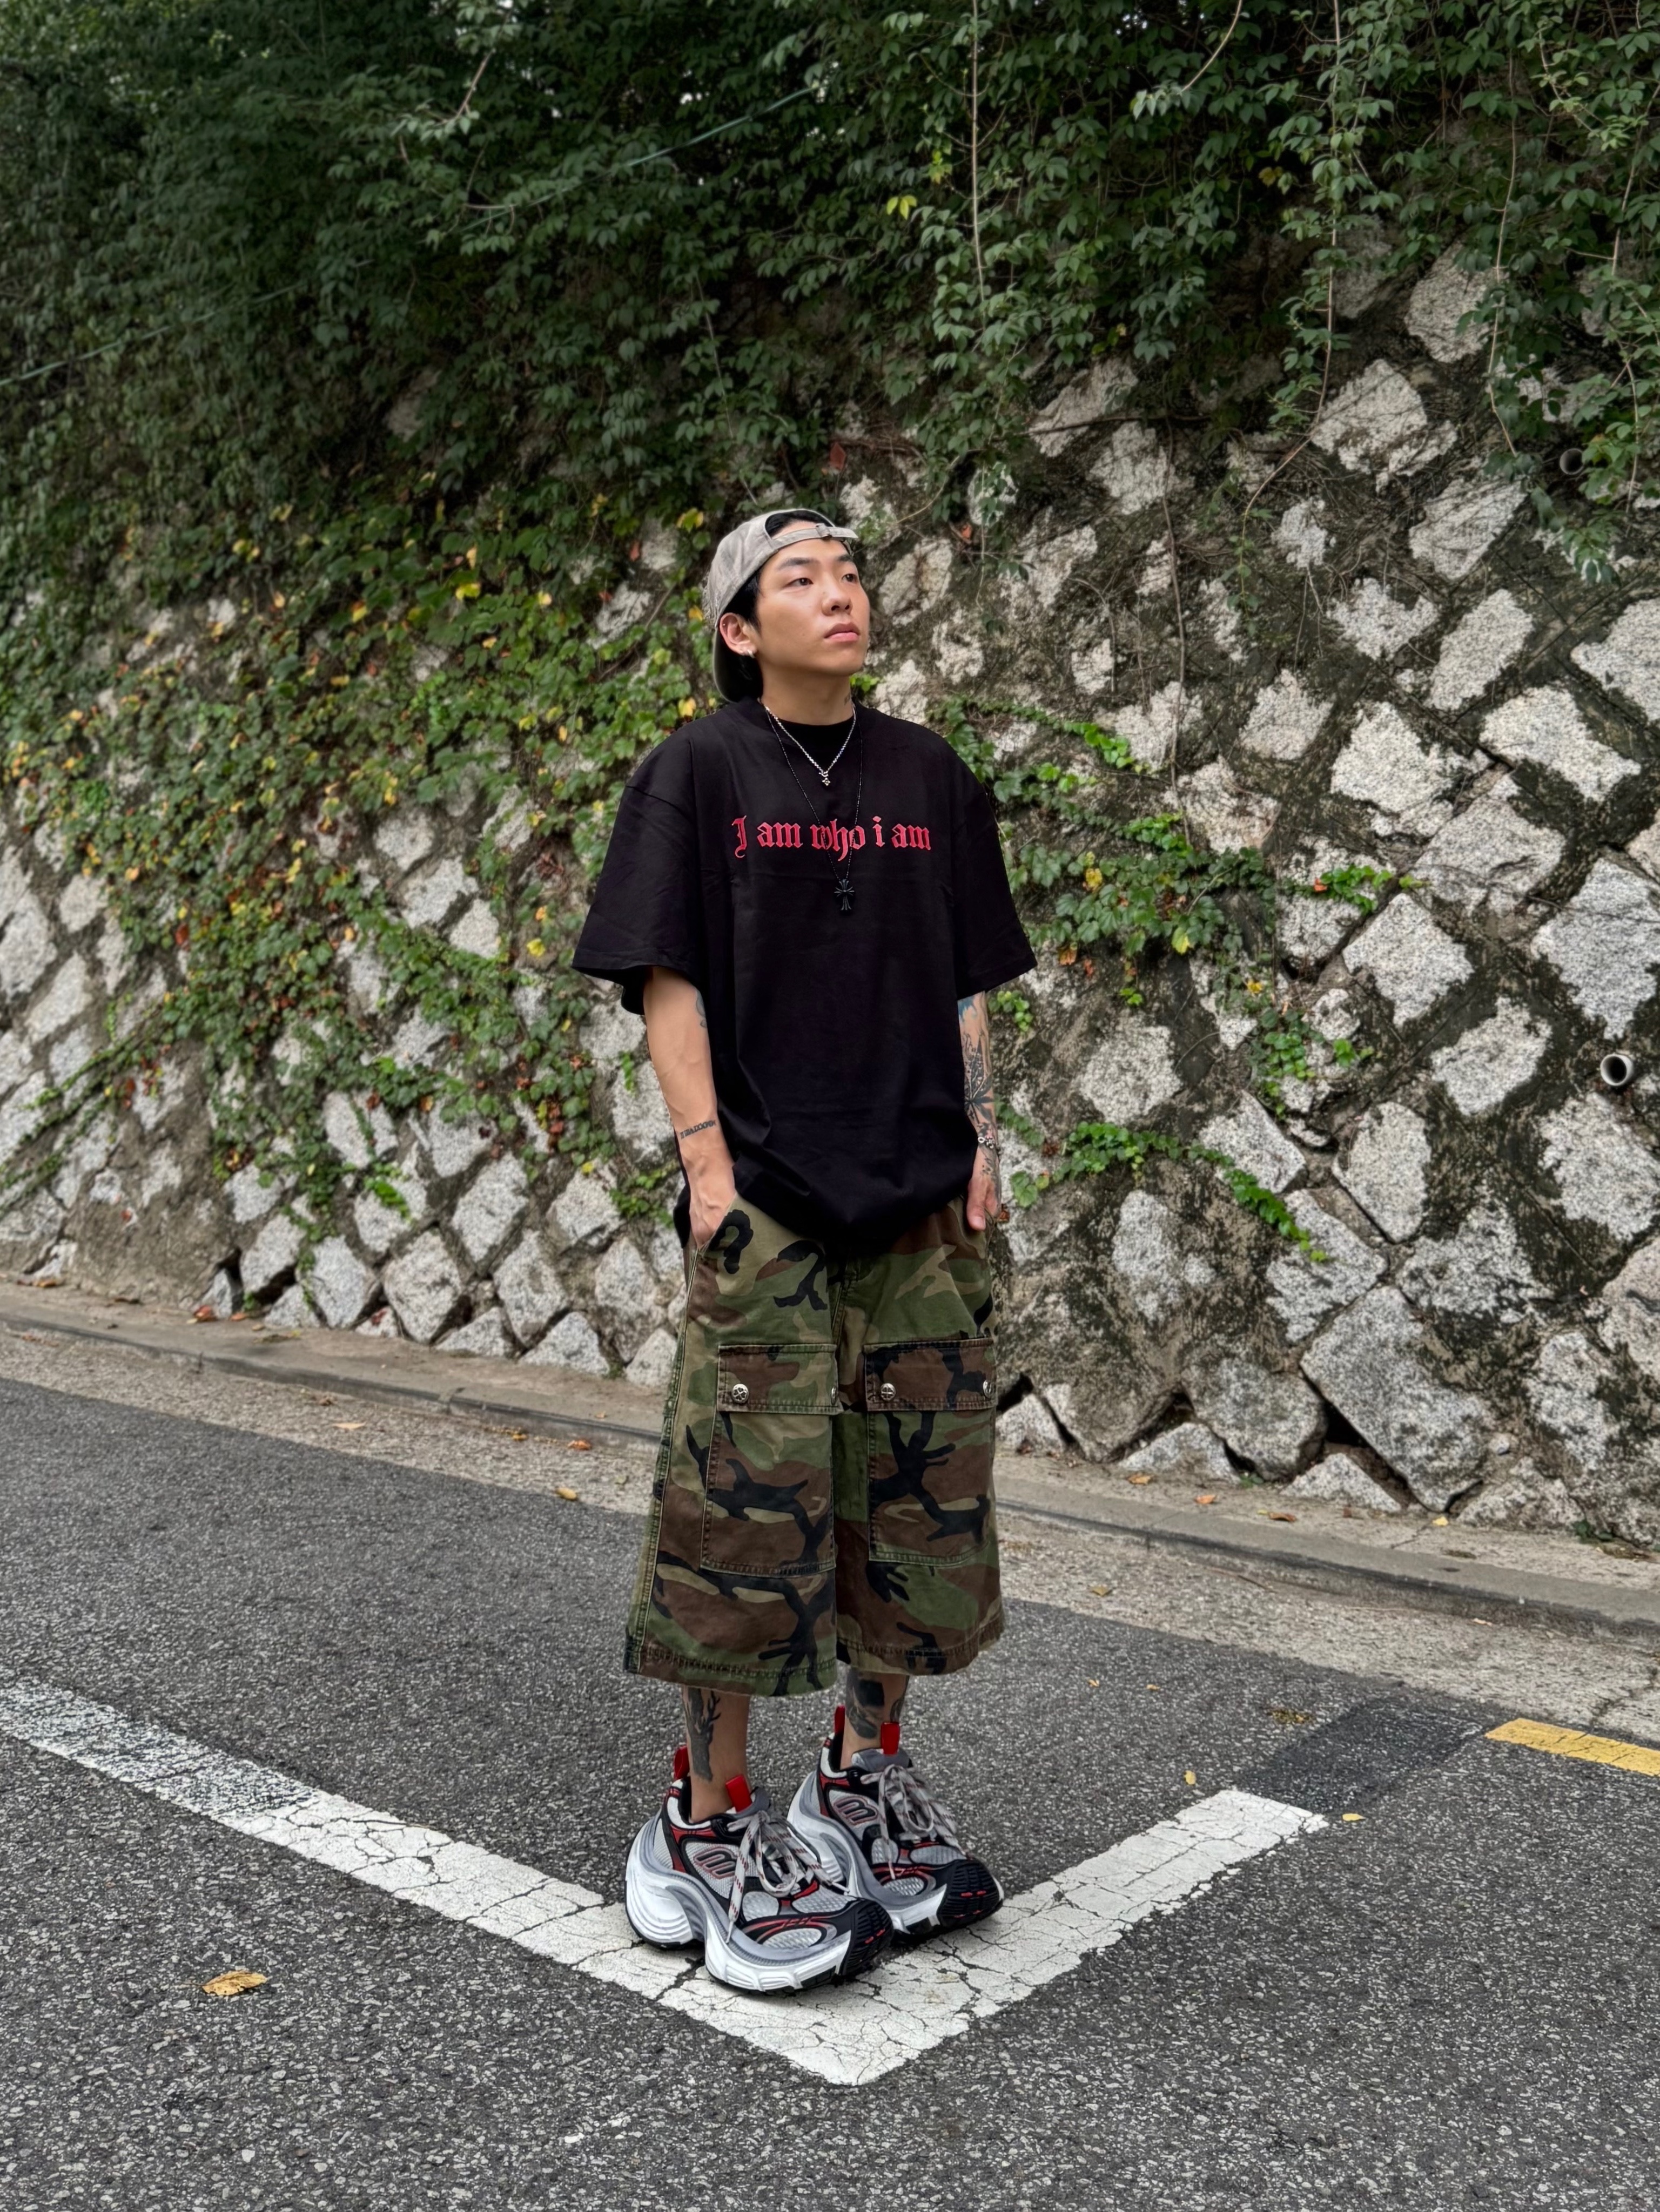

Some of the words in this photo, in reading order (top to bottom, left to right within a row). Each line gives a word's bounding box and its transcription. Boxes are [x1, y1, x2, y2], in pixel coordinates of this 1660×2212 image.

[757, 822, 803, 848] am
[810, 819, 865, 861] who
[872, 816, 885, 847] i
[891, 824, 931, 850] am
